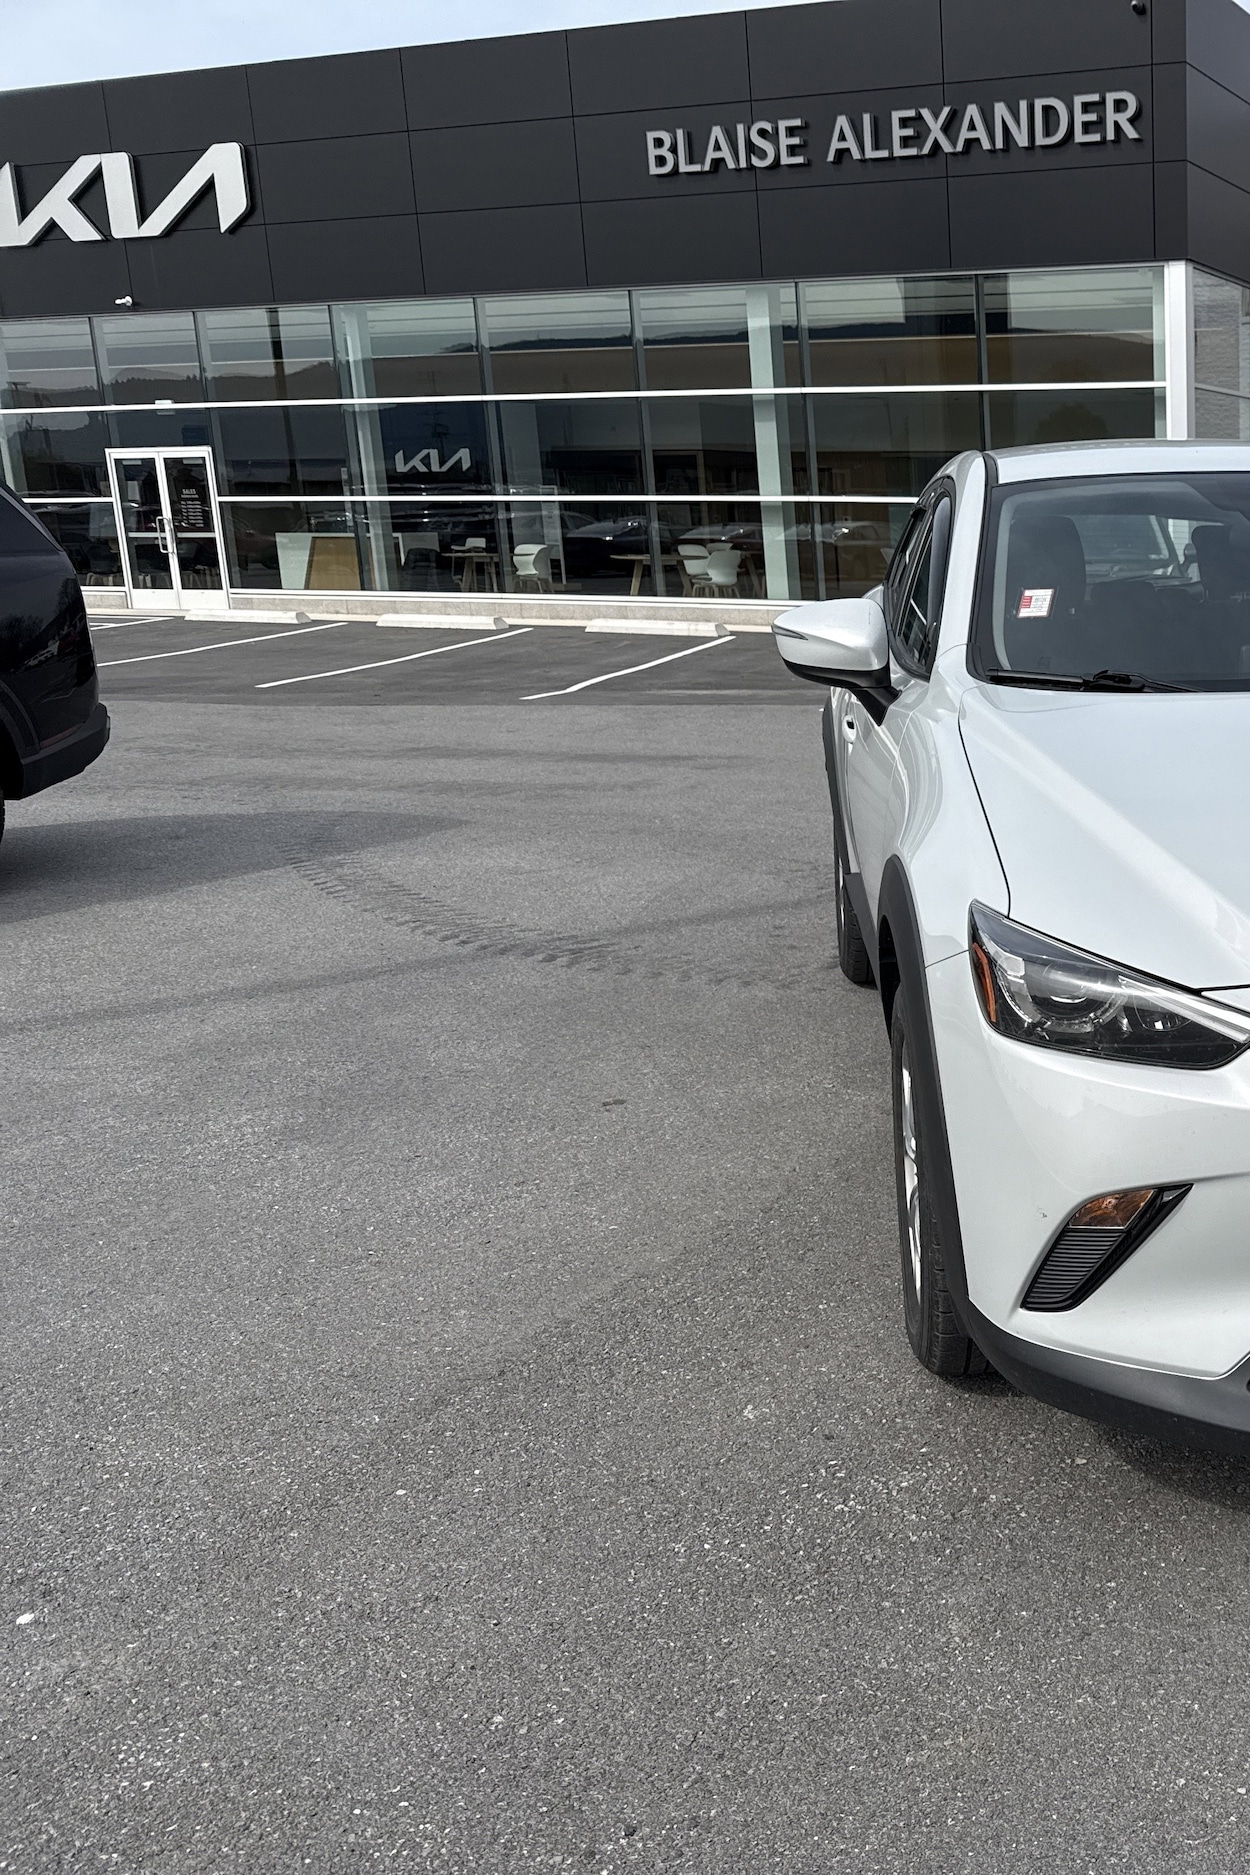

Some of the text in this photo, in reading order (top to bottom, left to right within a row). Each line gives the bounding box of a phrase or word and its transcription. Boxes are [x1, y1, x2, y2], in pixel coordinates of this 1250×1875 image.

[645, 90, 1143, 176] BLAISE ALEXANDER
[0, 141, 249, 248] KIA
[395, 447, 471, 473] KIA
